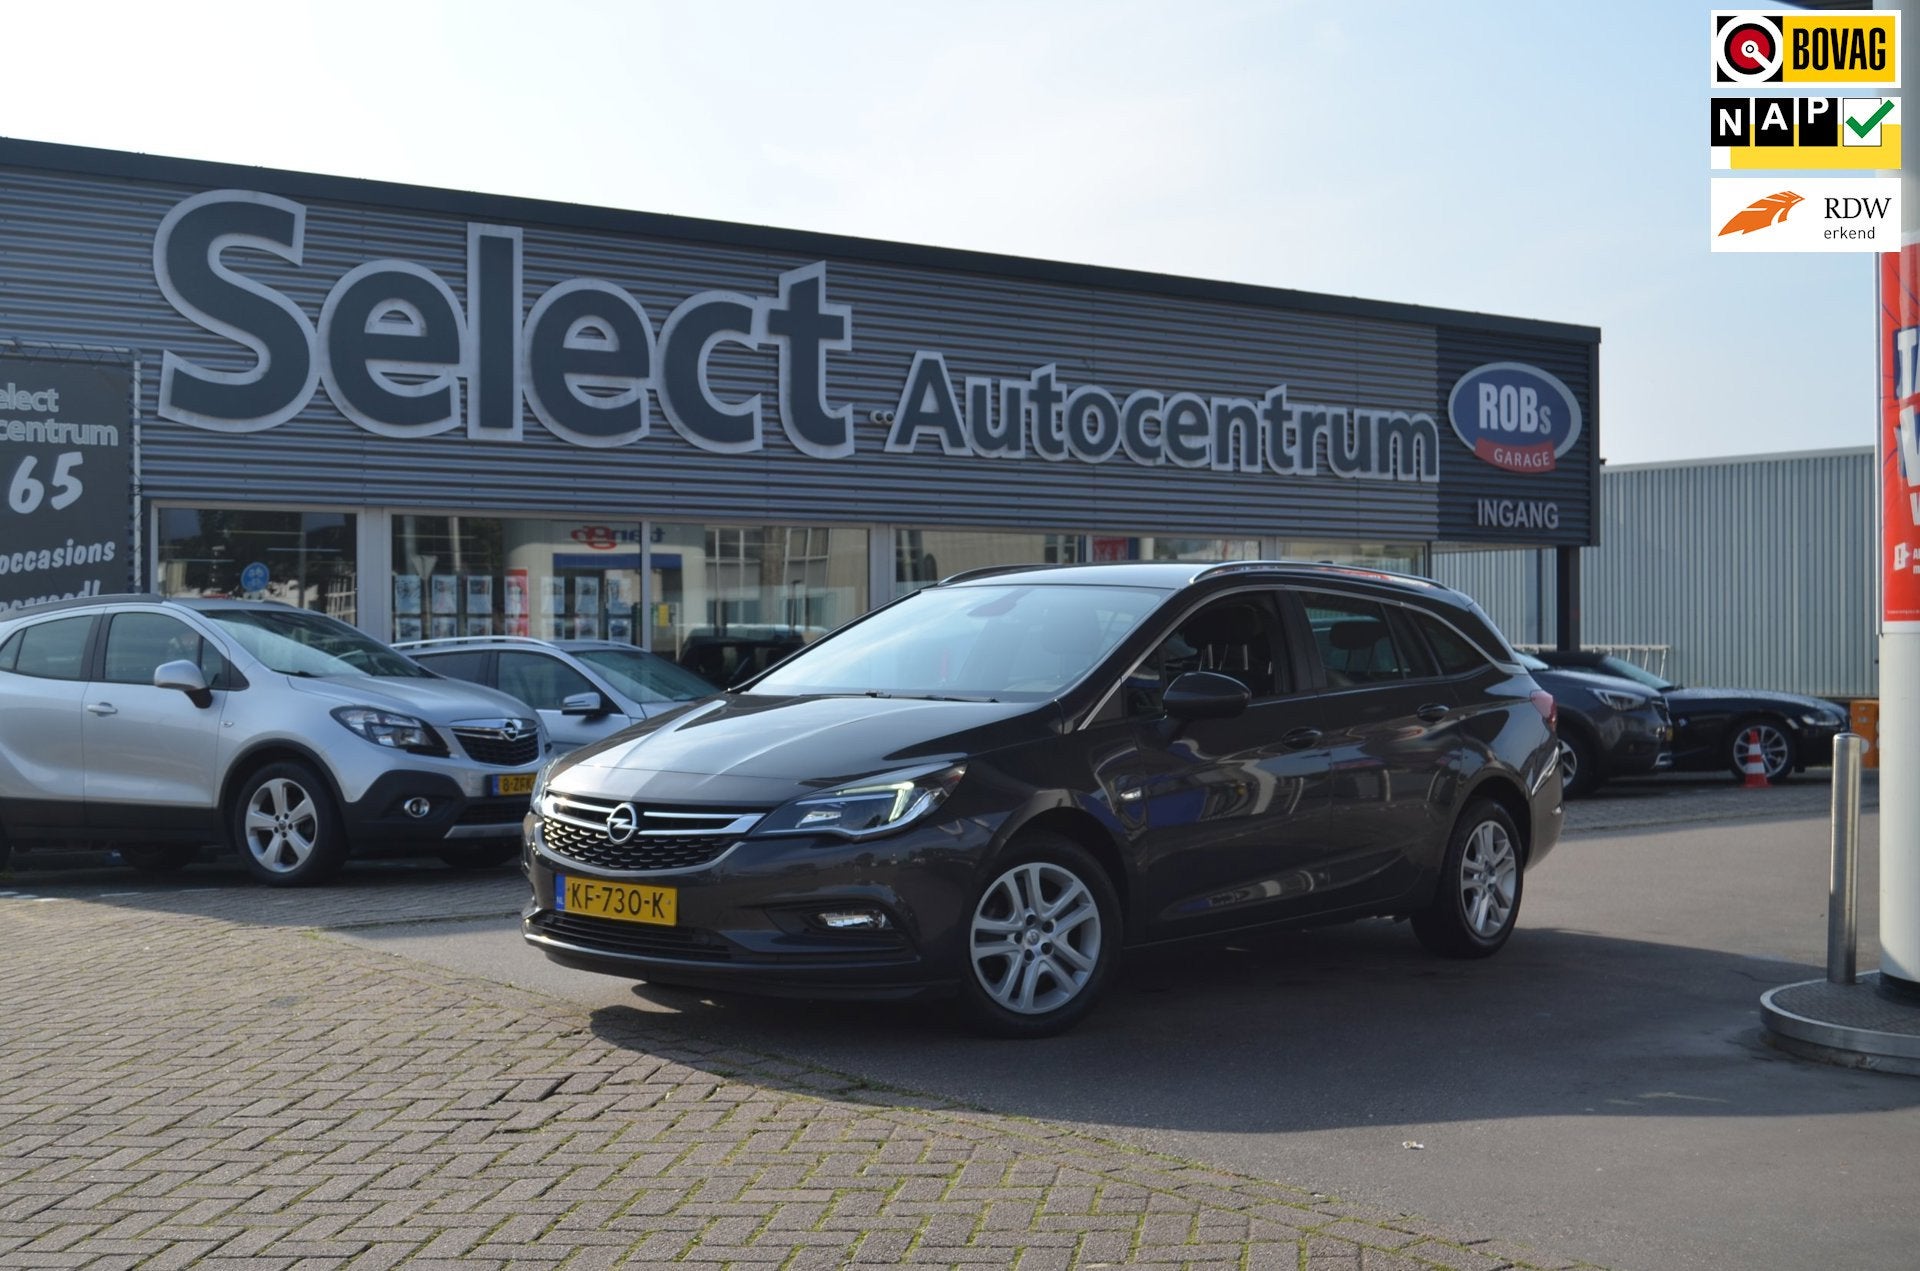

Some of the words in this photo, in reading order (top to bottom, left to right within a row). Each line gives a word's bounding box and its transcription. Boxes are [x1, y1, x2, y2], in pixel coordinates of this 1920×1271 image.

[153, 188, 856, 459] Select
[884, 349, 1441, 483] Autocentrum
[1493, 447, 1551, 468] GARAGE
[8, 451, 84, 514] 65
[1477, 499, 1560, 529] INGANG
[0, 538, 116, 575] occasions
[571, 882, 665, 919] KF-730-K
